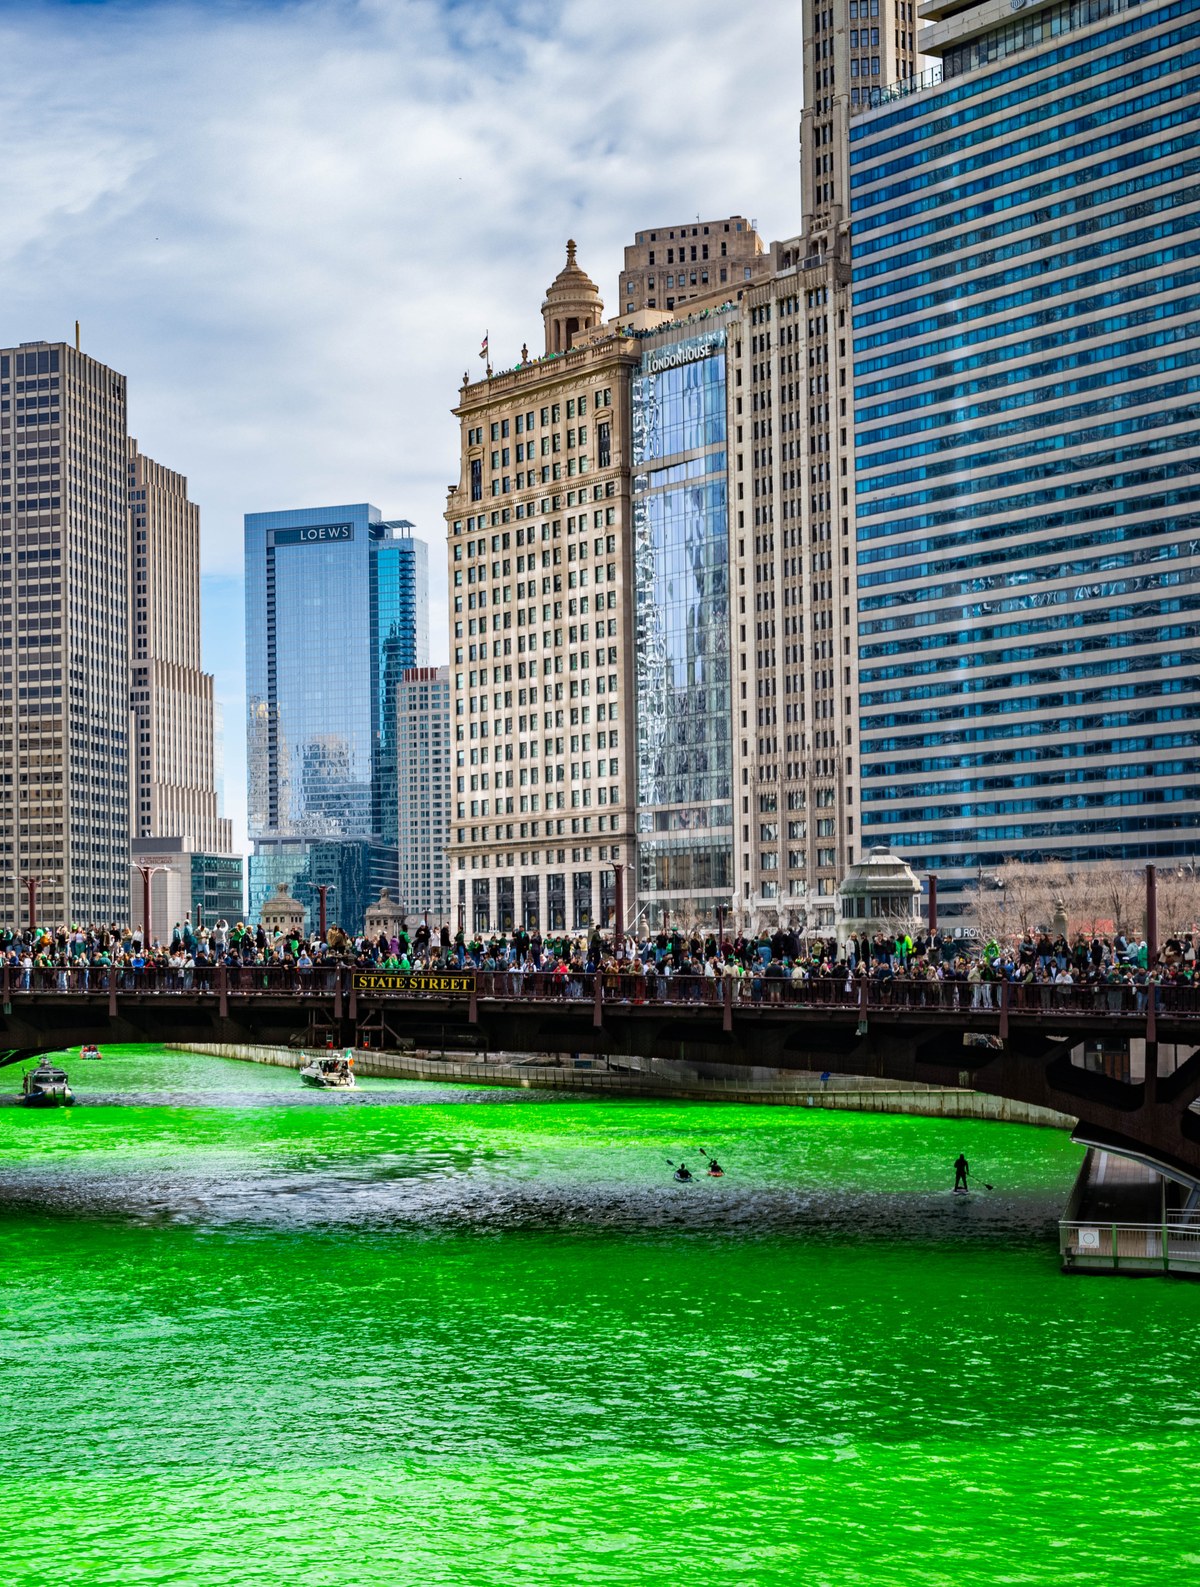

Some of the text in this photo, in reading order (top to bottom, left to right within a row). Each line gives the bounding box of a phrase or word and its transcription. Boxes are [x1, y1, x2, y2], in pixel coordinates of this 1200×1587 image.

[648, 343, 711, 373] LONDONHOUSE
[300, 526, 349, 540] LOEWS
[359, 976, 470, 990] STATE STREET
